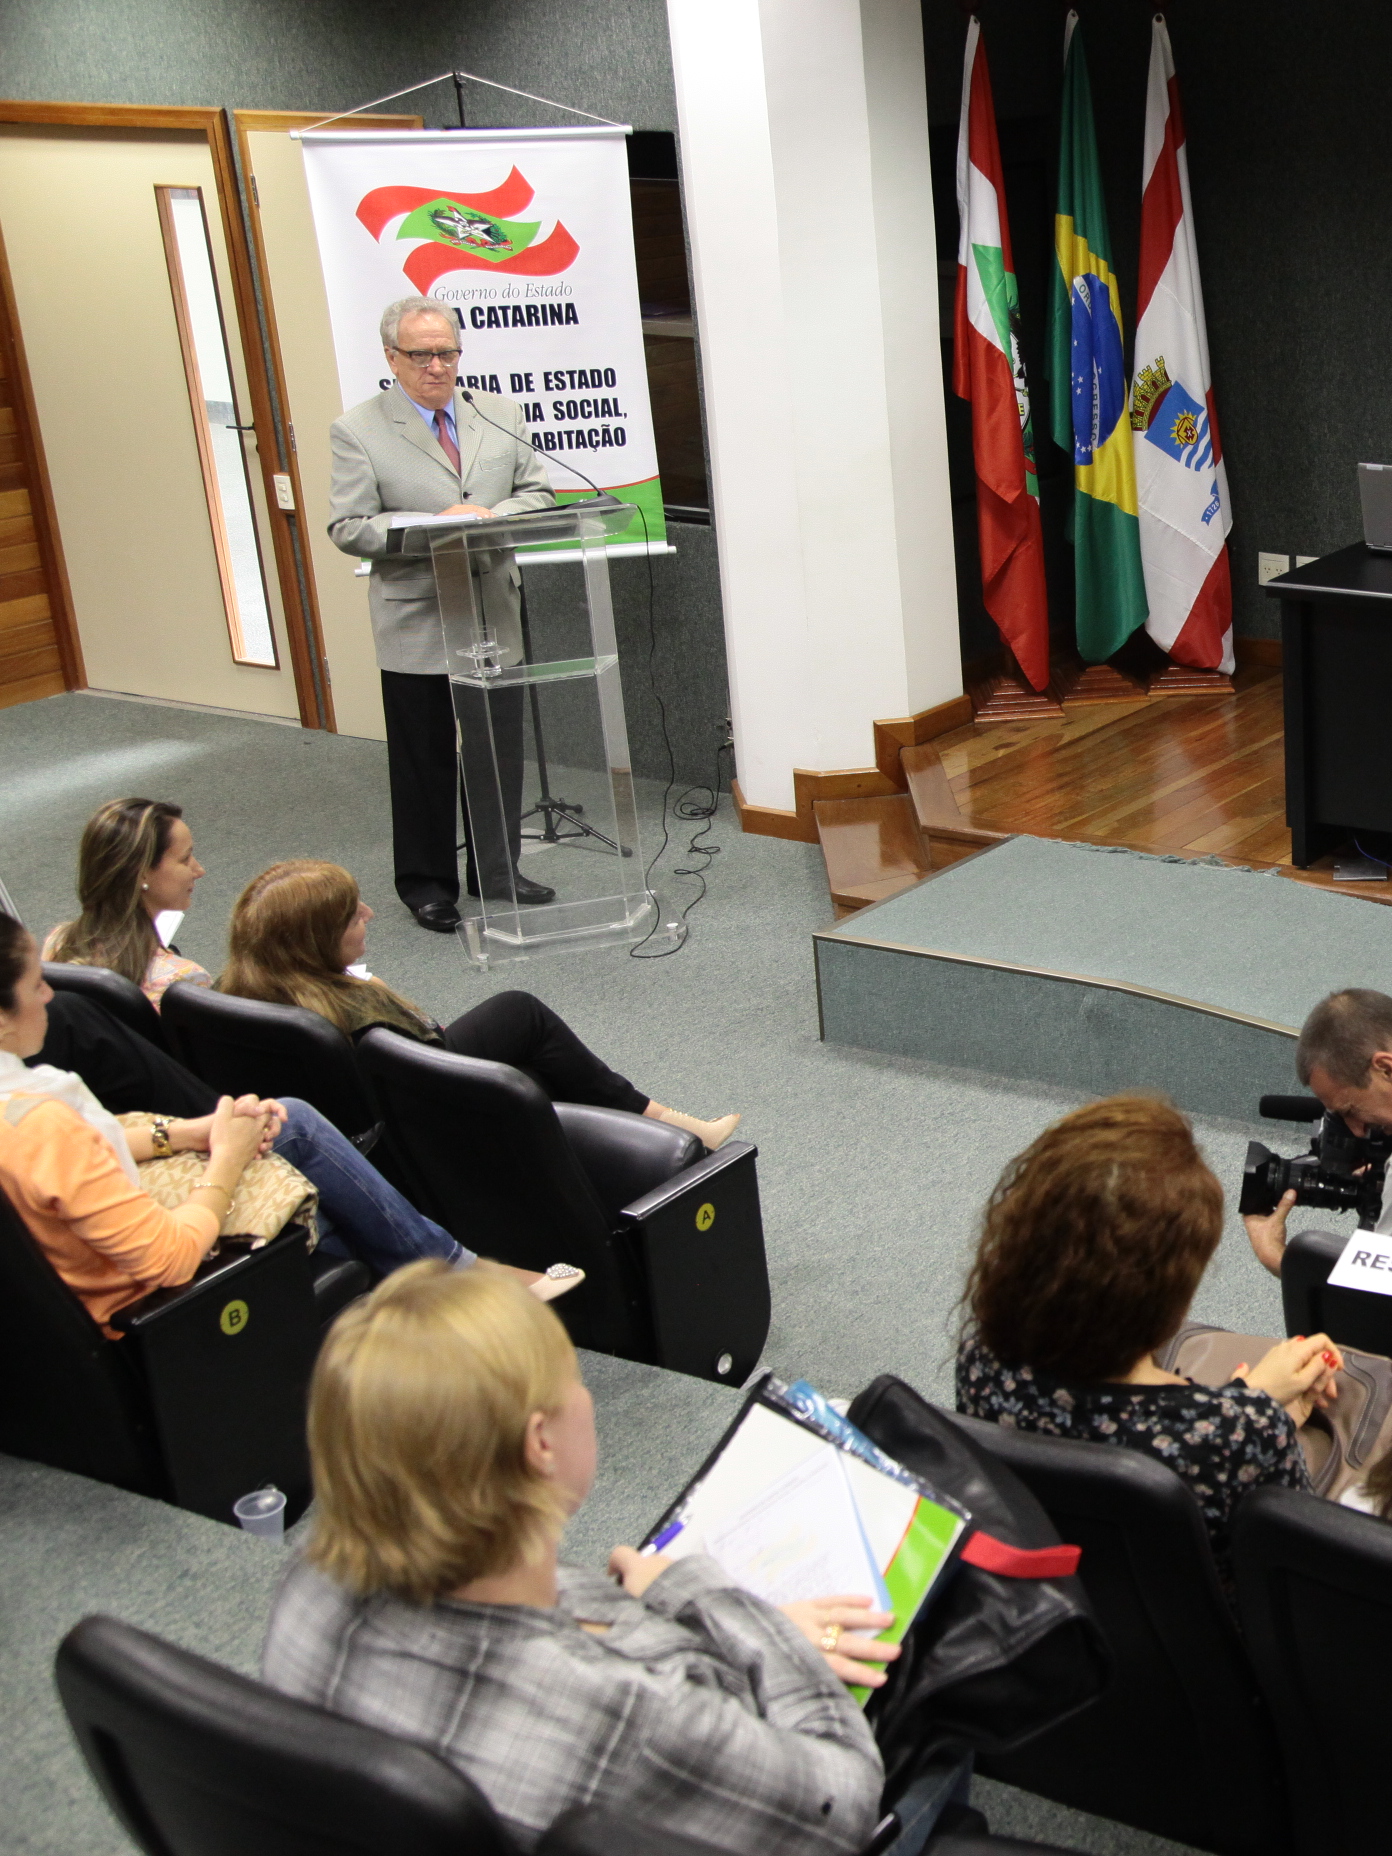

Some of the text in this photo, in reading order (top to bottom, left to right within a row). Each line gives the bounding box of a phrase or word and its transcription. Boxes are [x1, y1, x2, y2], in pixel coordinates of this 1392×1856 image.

[434, 281, 573, 301] Governo do Estado
[470, 302, 580, 330] CATARINA
[510, 372, 536, 395] DE
[543, 367, 618, 392] ESTADO
[552, 397, 629, 422] SOCIAL,
[531, 423, 628, 453] ABITAÇÃO
[702, 1209, 712, 1225] A
[228, 1308, 242, 1328] B
